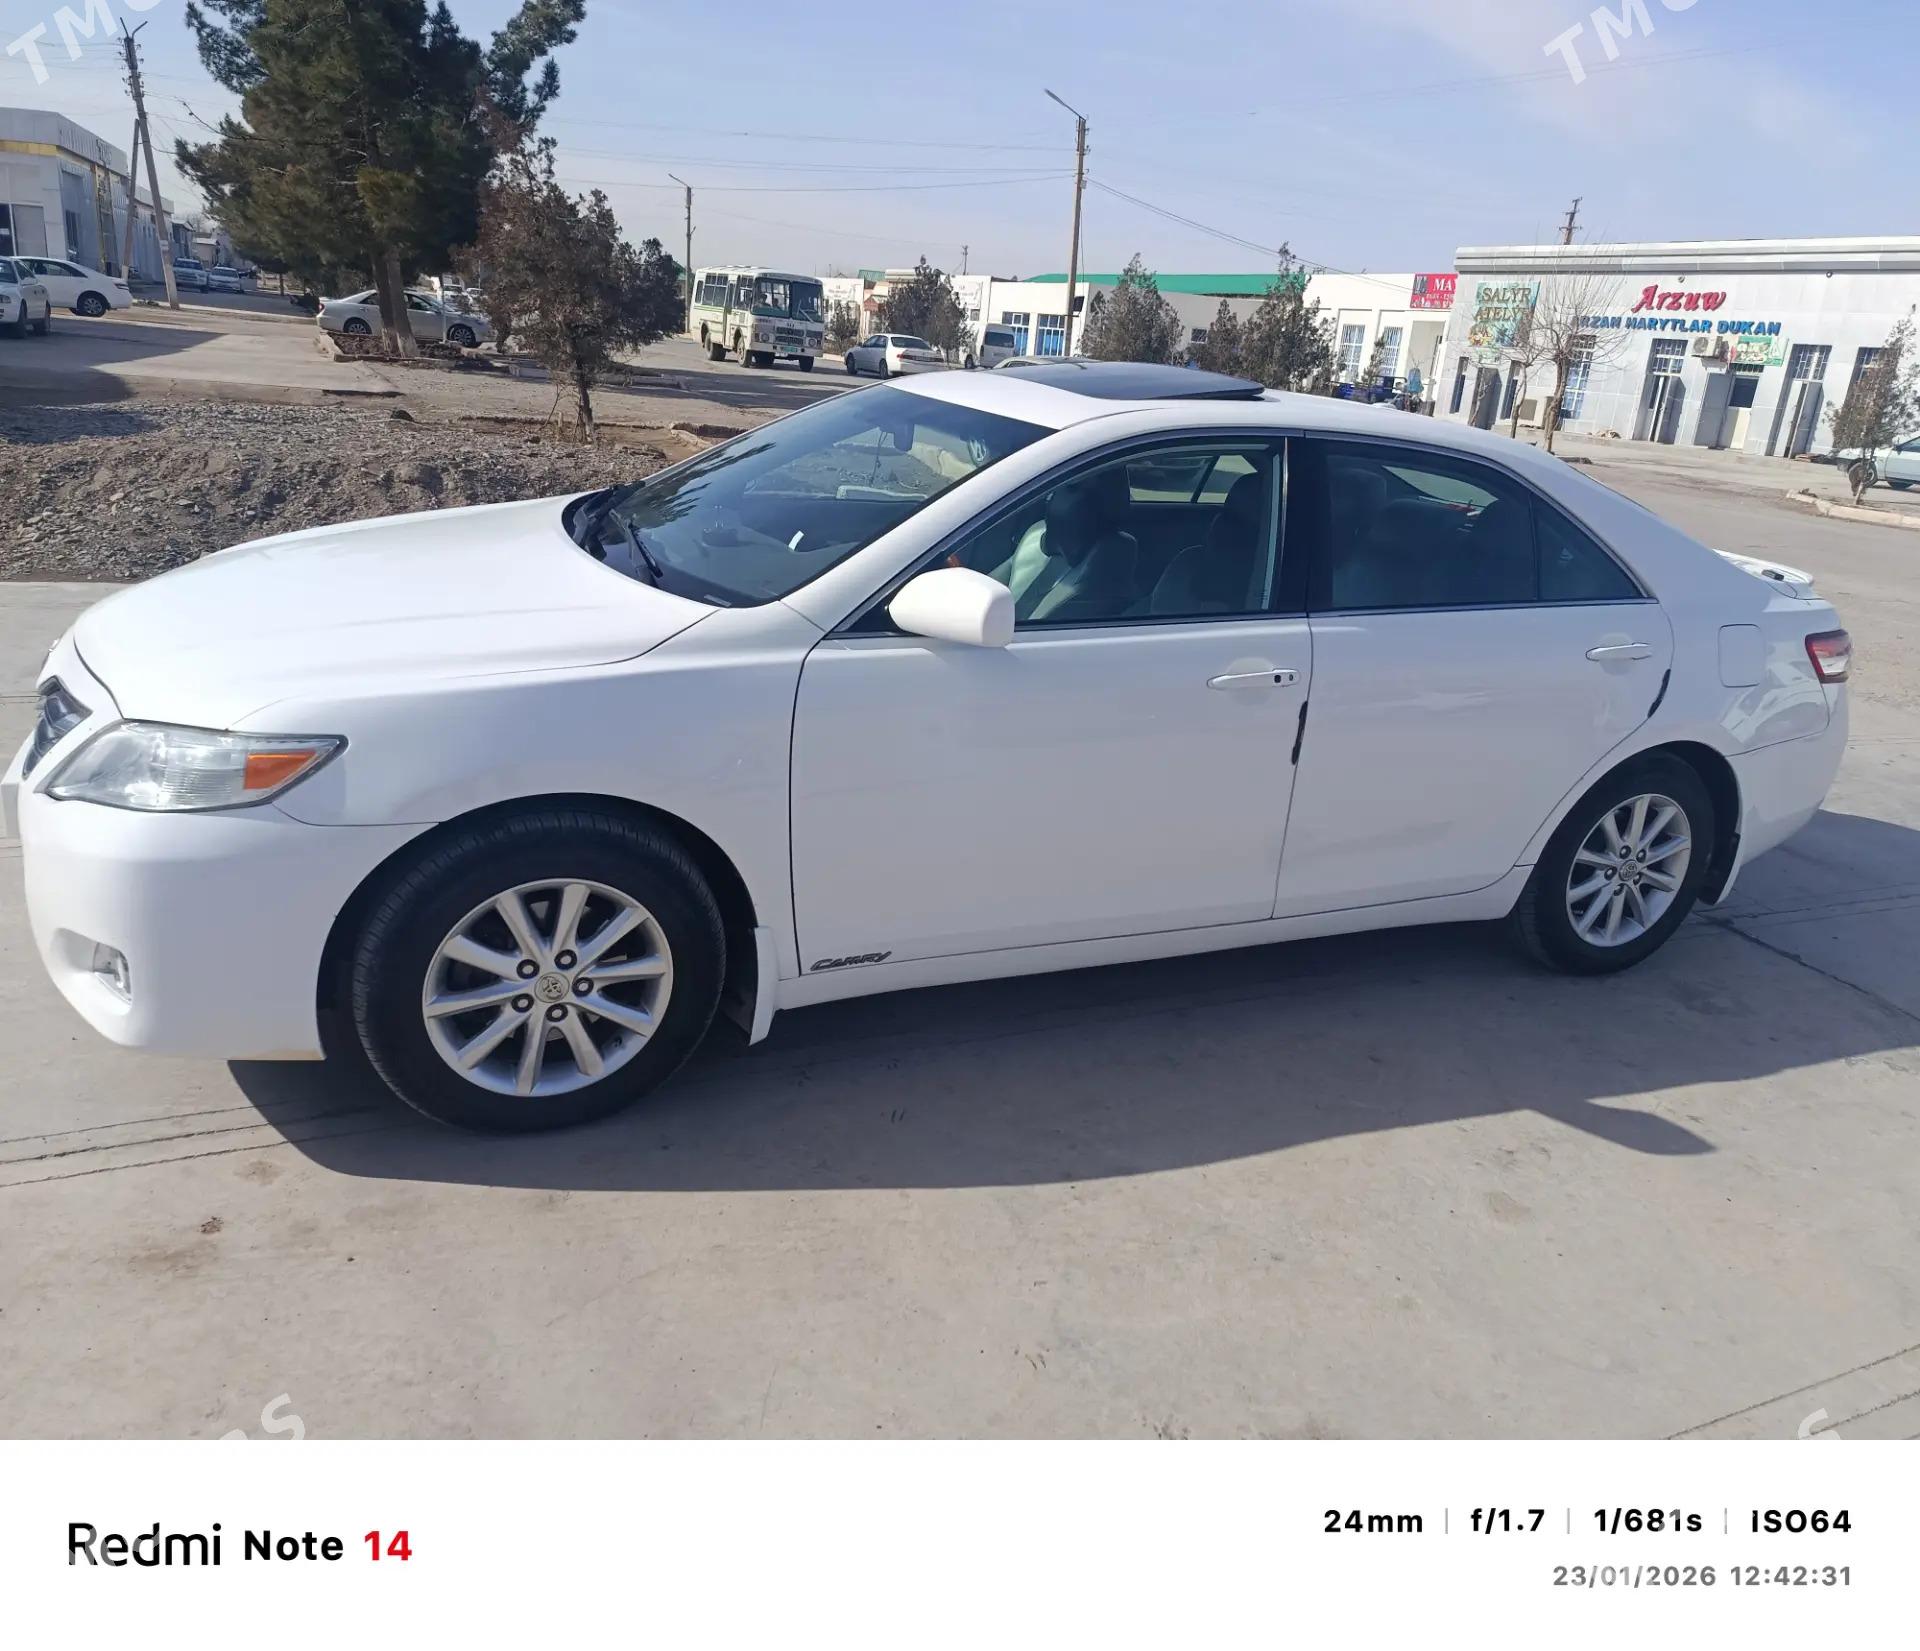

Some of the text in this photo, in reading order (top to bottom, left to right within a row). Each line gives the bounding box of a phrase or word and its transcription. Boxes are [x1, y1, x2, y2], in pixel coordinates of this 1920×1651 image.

[1434, 278, 1456, 291] MA
[1630, 284, 1727, 313] Arzuw
[1624, 316, 1713, 333] HARYTLAR
[1716, 319, 1782, 336] DUKAN
[809, 951, 892, 971] CAMRY
